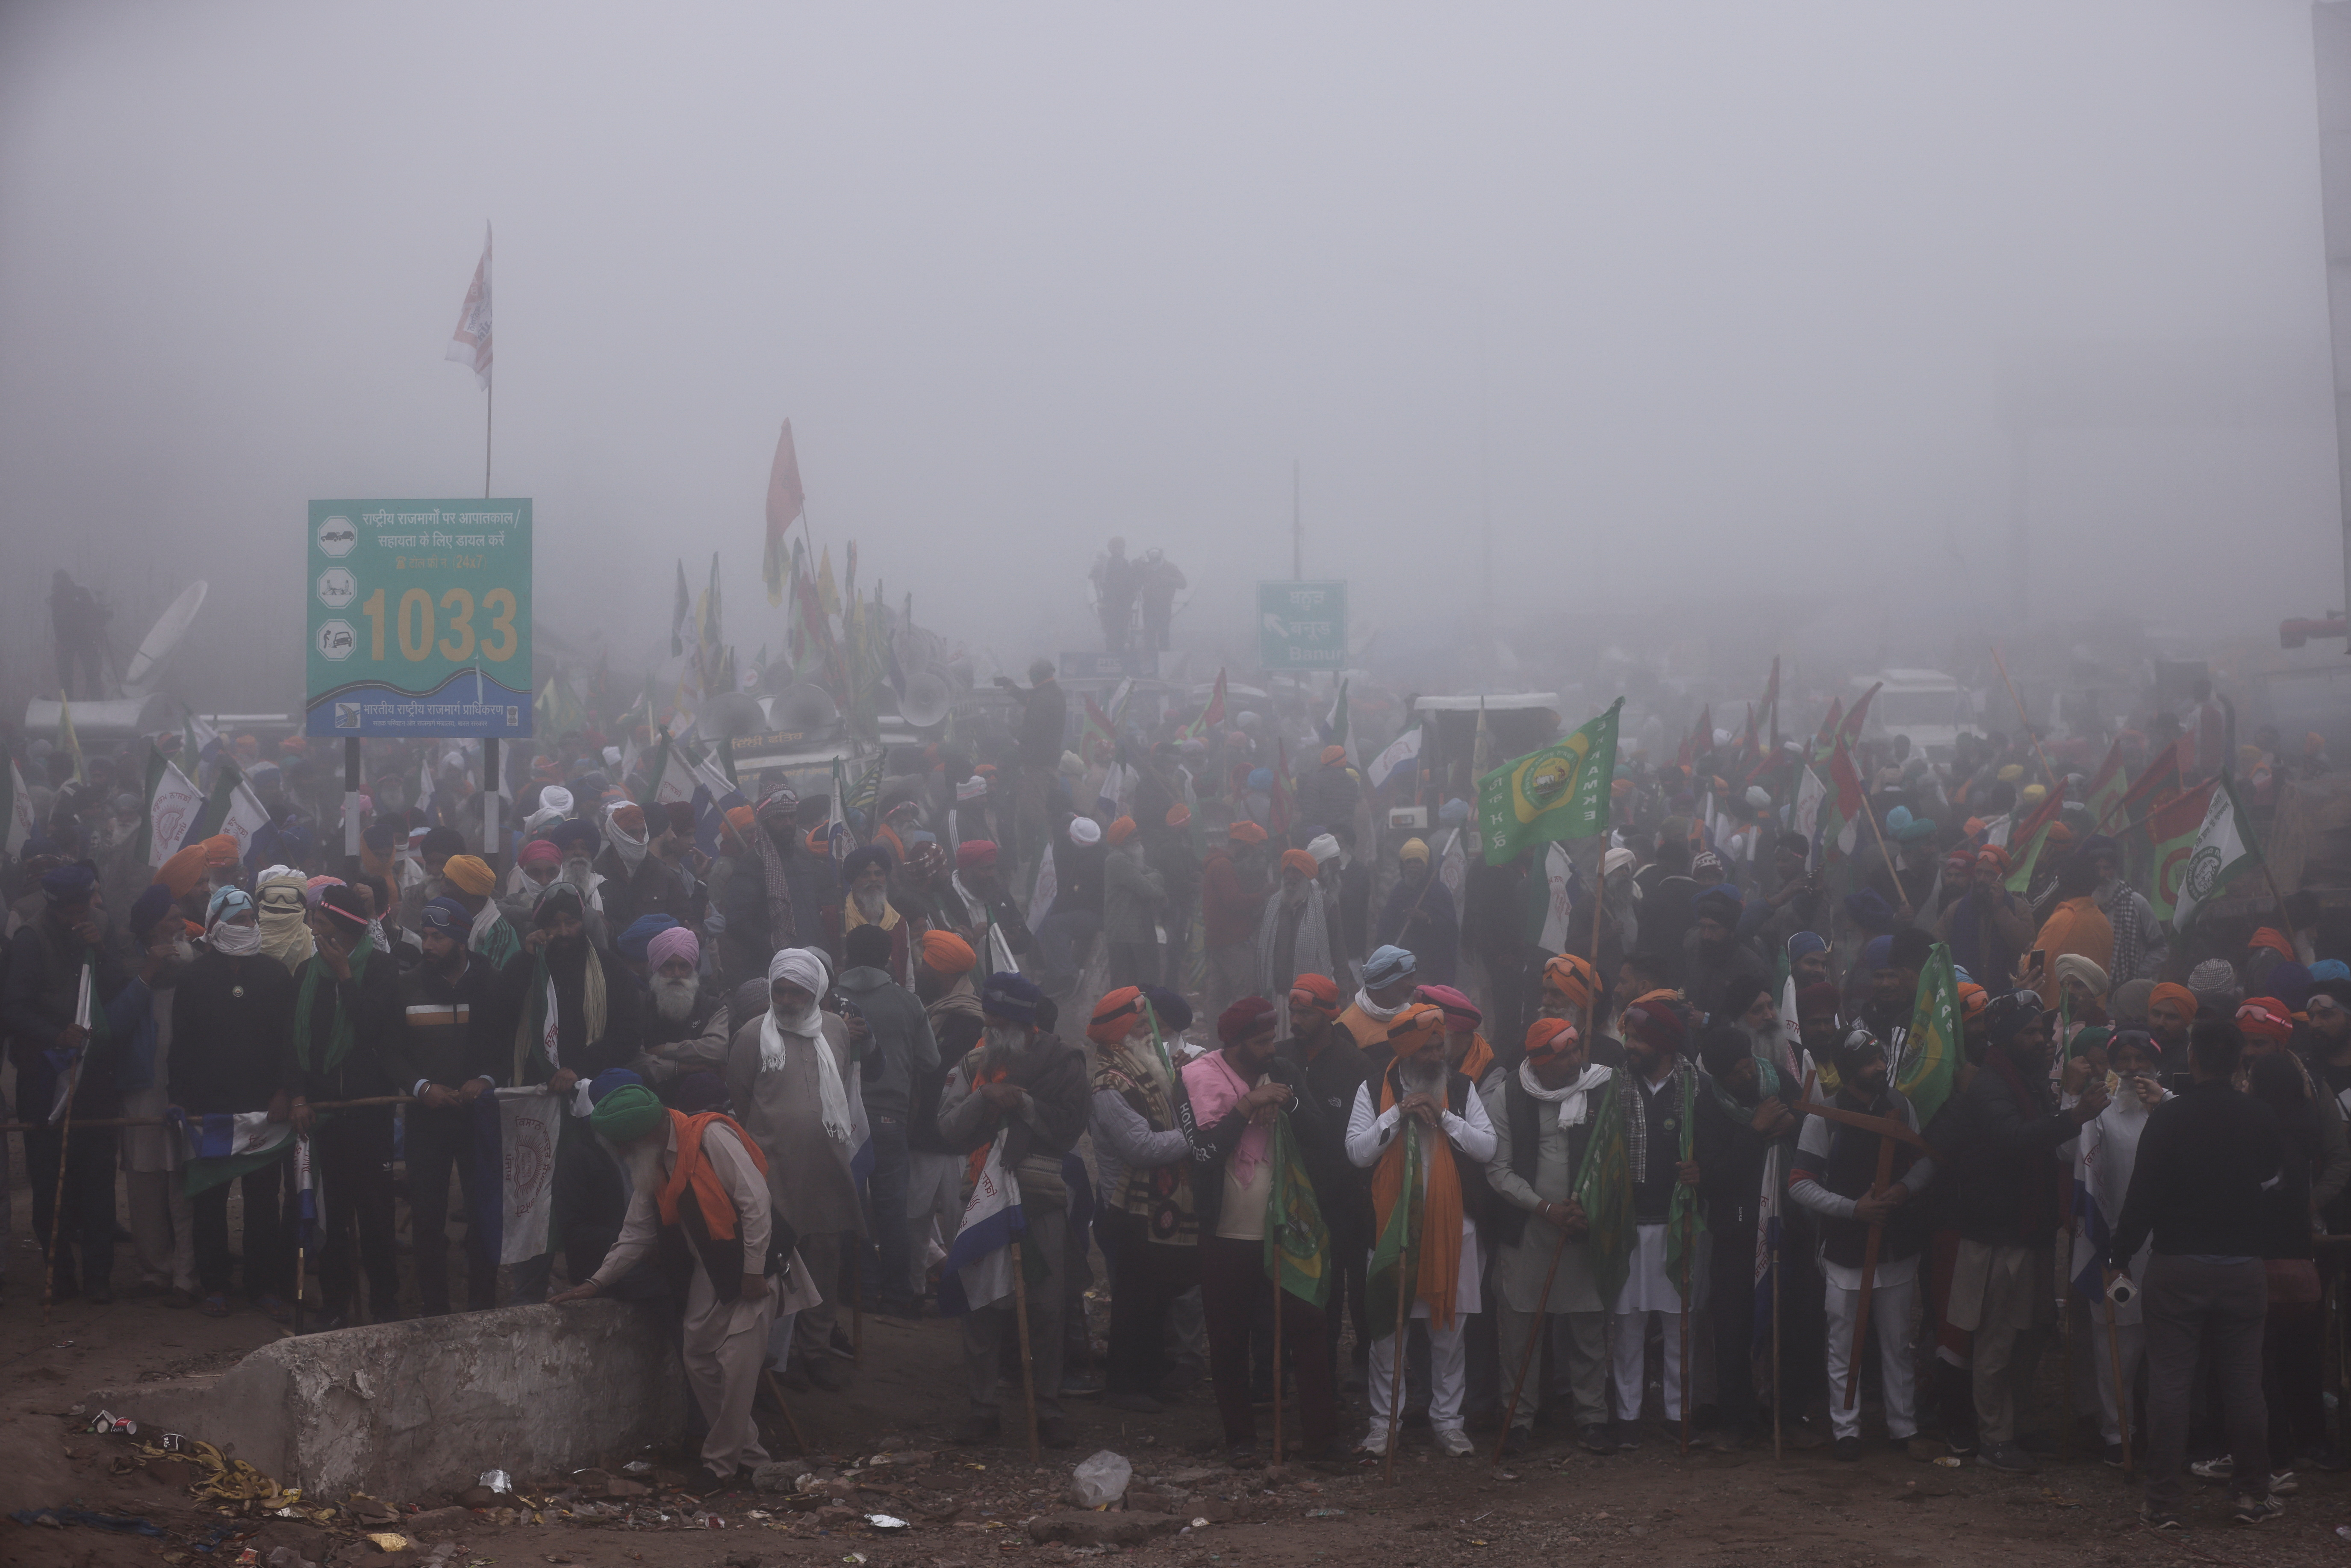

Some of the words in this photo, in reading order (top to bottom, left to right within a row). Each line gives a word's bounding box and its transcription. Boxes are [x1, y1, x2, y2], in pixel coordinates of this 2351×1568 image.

[363, 509, 395, 527] राष्ट्रीय
[397, 509, 440, 525] राजमार्गों
[442, 513, 456, 525] पर
[378, 536, 416, 548] सहायता
[419, 531, 430, 547] के
[432, 531, 453, 549] लिए
[456, 536, 485, 547] डायल
[488, 531, 505, 546] करें
[409, 555, 425, 569] टोल
[427, 555, 438, 569] फ्री
[453, 554, 487, 571] (24x7)
[363, 588, 518, 662] 1033
[1290, 646, 1343, 660] Banur
[1098, 658, 1121, 666] PTC
[363, 701, 394, 714] भारतीय
[397, 701, 424, 717] राष्ट्रीय
[427, 701, 460, 715] राजमार्ग
[463, 701, 504, 715] प्राधिकरण
[515, 1116, 544, 1130] ਕਿਸਾਨ
[1180, 1102, 1211, 1162] HOLLISTER
[505, 1153, 514, 1182] ਪੰਜਾਬ
